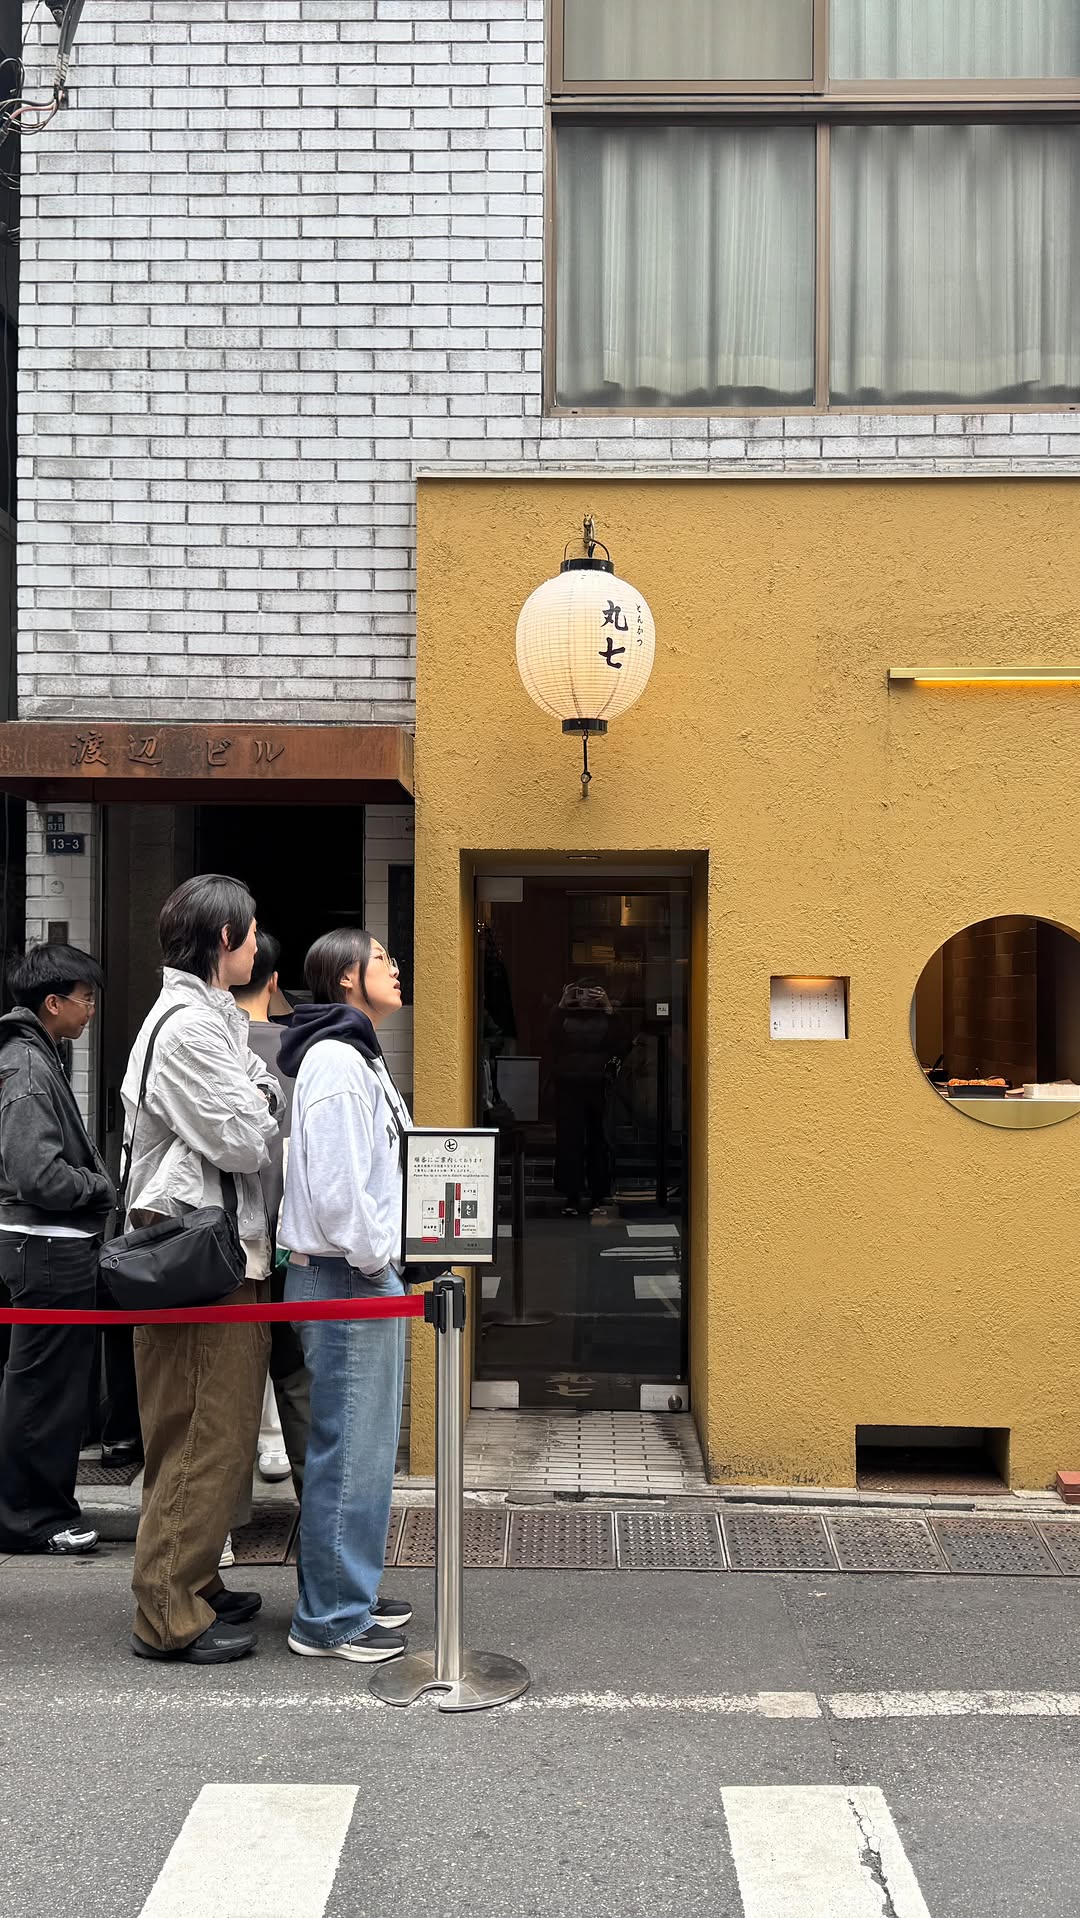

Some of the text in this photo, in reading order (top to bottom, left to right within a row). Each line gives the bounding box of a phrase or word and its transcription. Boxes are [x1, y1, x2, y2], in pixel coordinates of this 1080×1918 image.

[599, 600, 629, 669] 丸七
[635, 603, 644, 647] とんかつ
[70, 730, 286, 767] 渡辺ビル
[52, 838, 80, 850] 13-3
